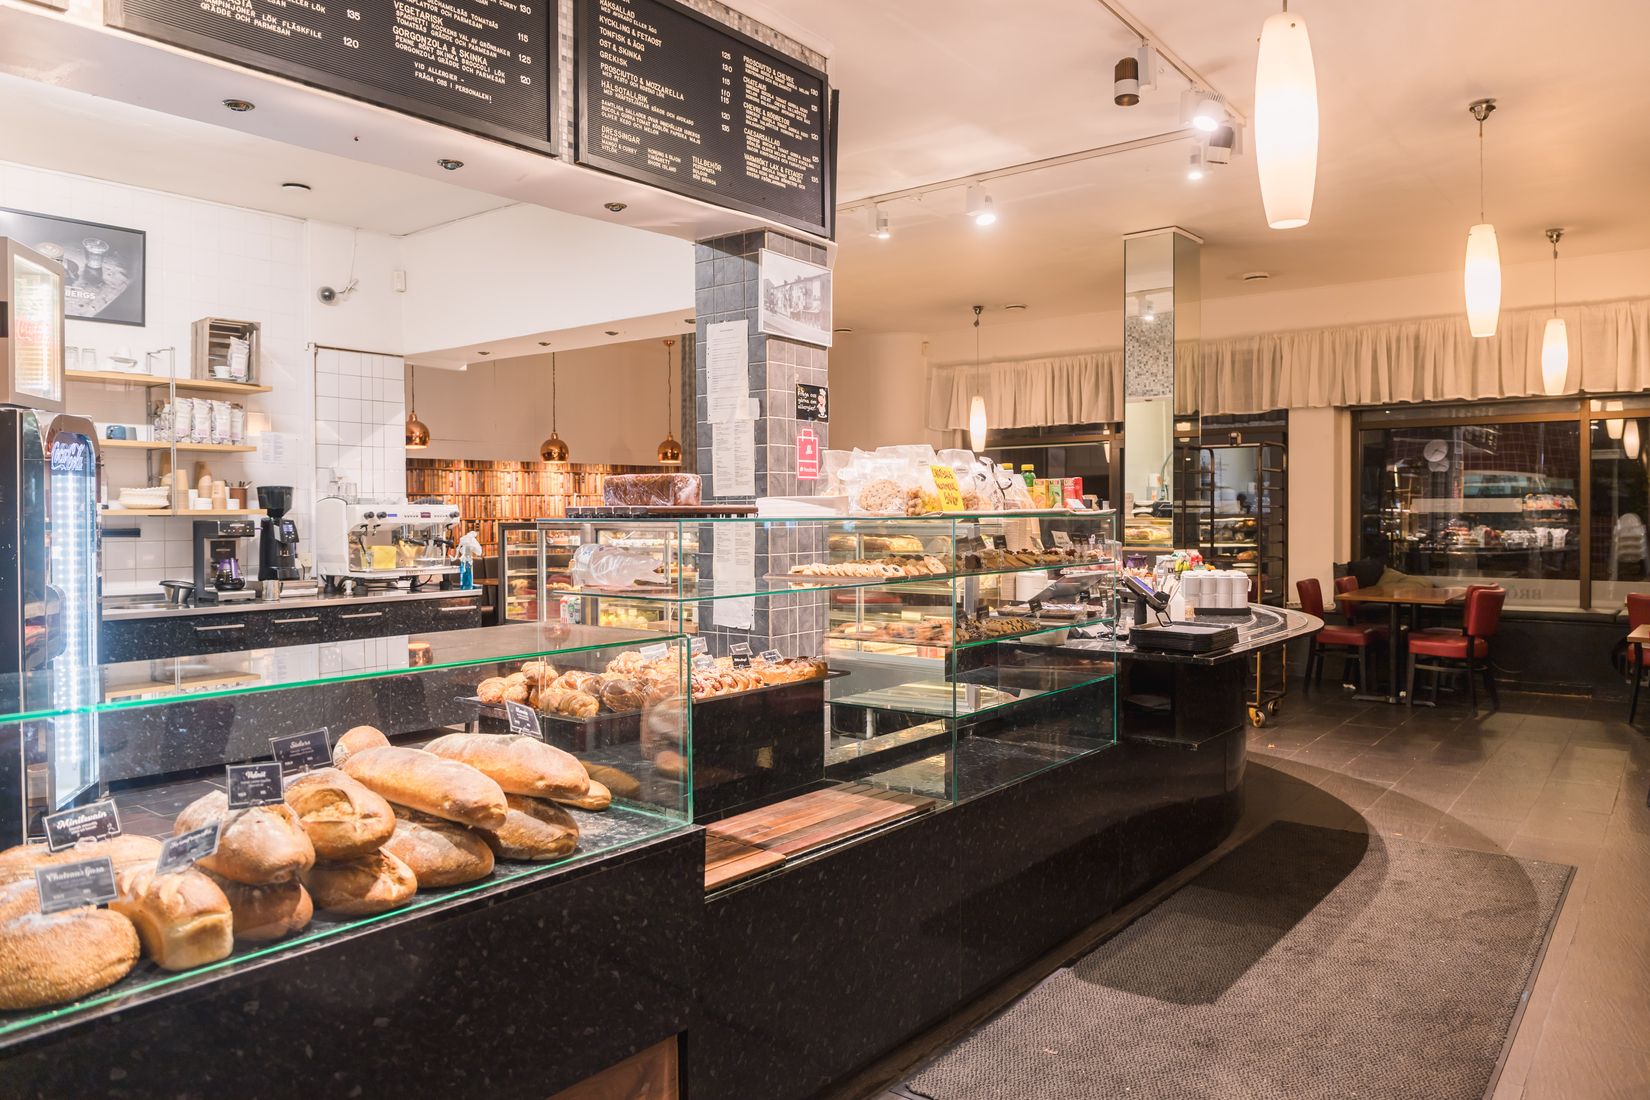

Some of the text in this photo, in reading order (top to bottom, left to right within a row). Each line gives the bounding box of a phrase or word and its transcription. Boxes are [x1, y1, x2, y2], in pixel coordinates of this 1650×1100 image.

[347, 9, 360, 21] 135
[394, 0, 443, 26] VEGETARISK
[519, 4, 531, 15] 130
[200, 1, 232, 18] GRÄDDE
[235, 13, 251, 23] OCH
[254, 19, 290, 36] PARMESAN
[518, 32, 529, 43] 115
[600, 15, 661, 48] KYCKLING & FETAOST
[600, 26, 625, 44] TONFISK
[627, 38, 632, 46] &
[343, 36, 359, 49] 120
[393, 25, 488, 66] GORGONZOLA & SKINKA
[600, 38, 642, 62] OST & SKINKA
[519, 53, 531, 65] 125
[600, 50, 628, 67] GREKISK
[722, 63, 732, 74] 130
[520, 75, 531, 86] 120
[601, 62, 684, 101] PROSCIUTTO & MOZZARELLA
[721, 88, 730, 98] 110
[721, 95, 729, 105] 115
[721, 111, 730, 121] 120
[602, 125, 640, 145] DRESSINGAR
